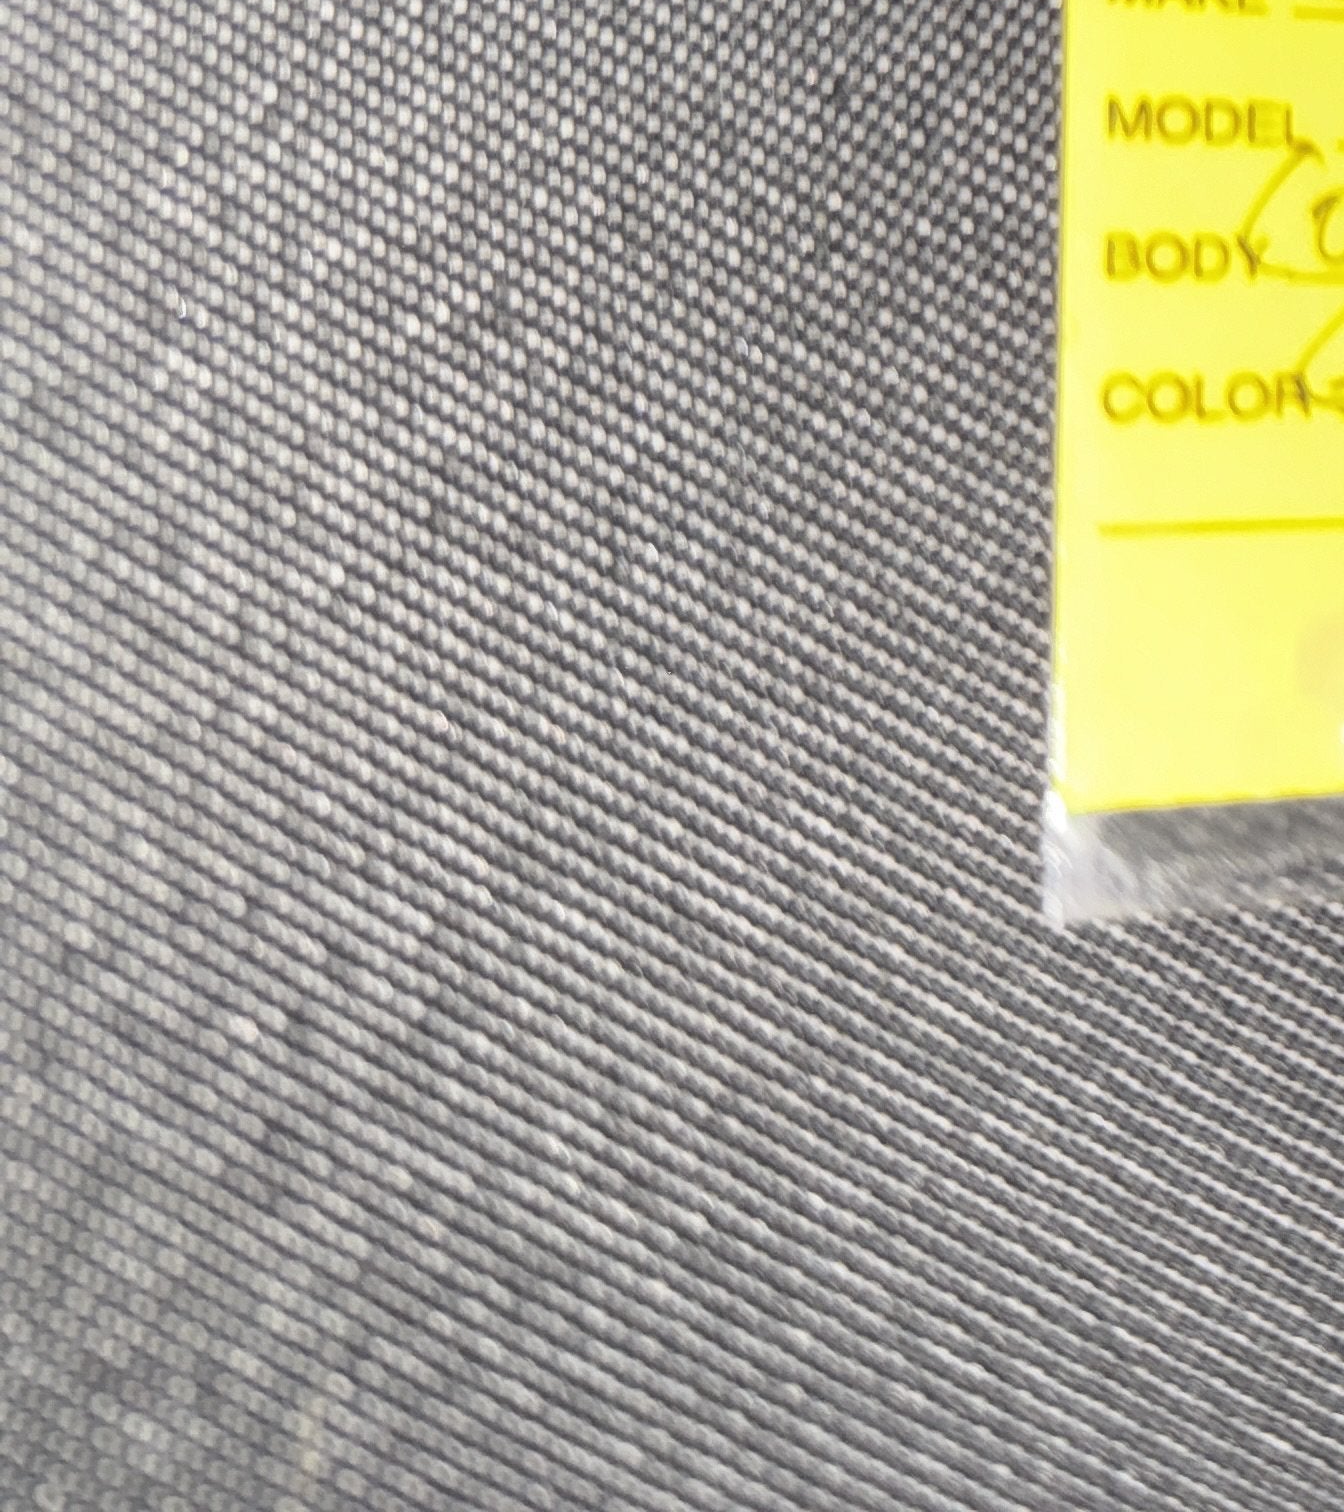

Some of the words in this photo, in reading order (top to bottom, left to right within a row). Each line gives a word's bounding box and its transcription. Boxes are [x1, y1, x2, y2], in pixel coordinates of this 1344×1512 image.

[1106, 95, 1297, 147] MODEL
[1105, 231, 1265, 281] BODY
[1102, 372, 1315, 423] COLOR
